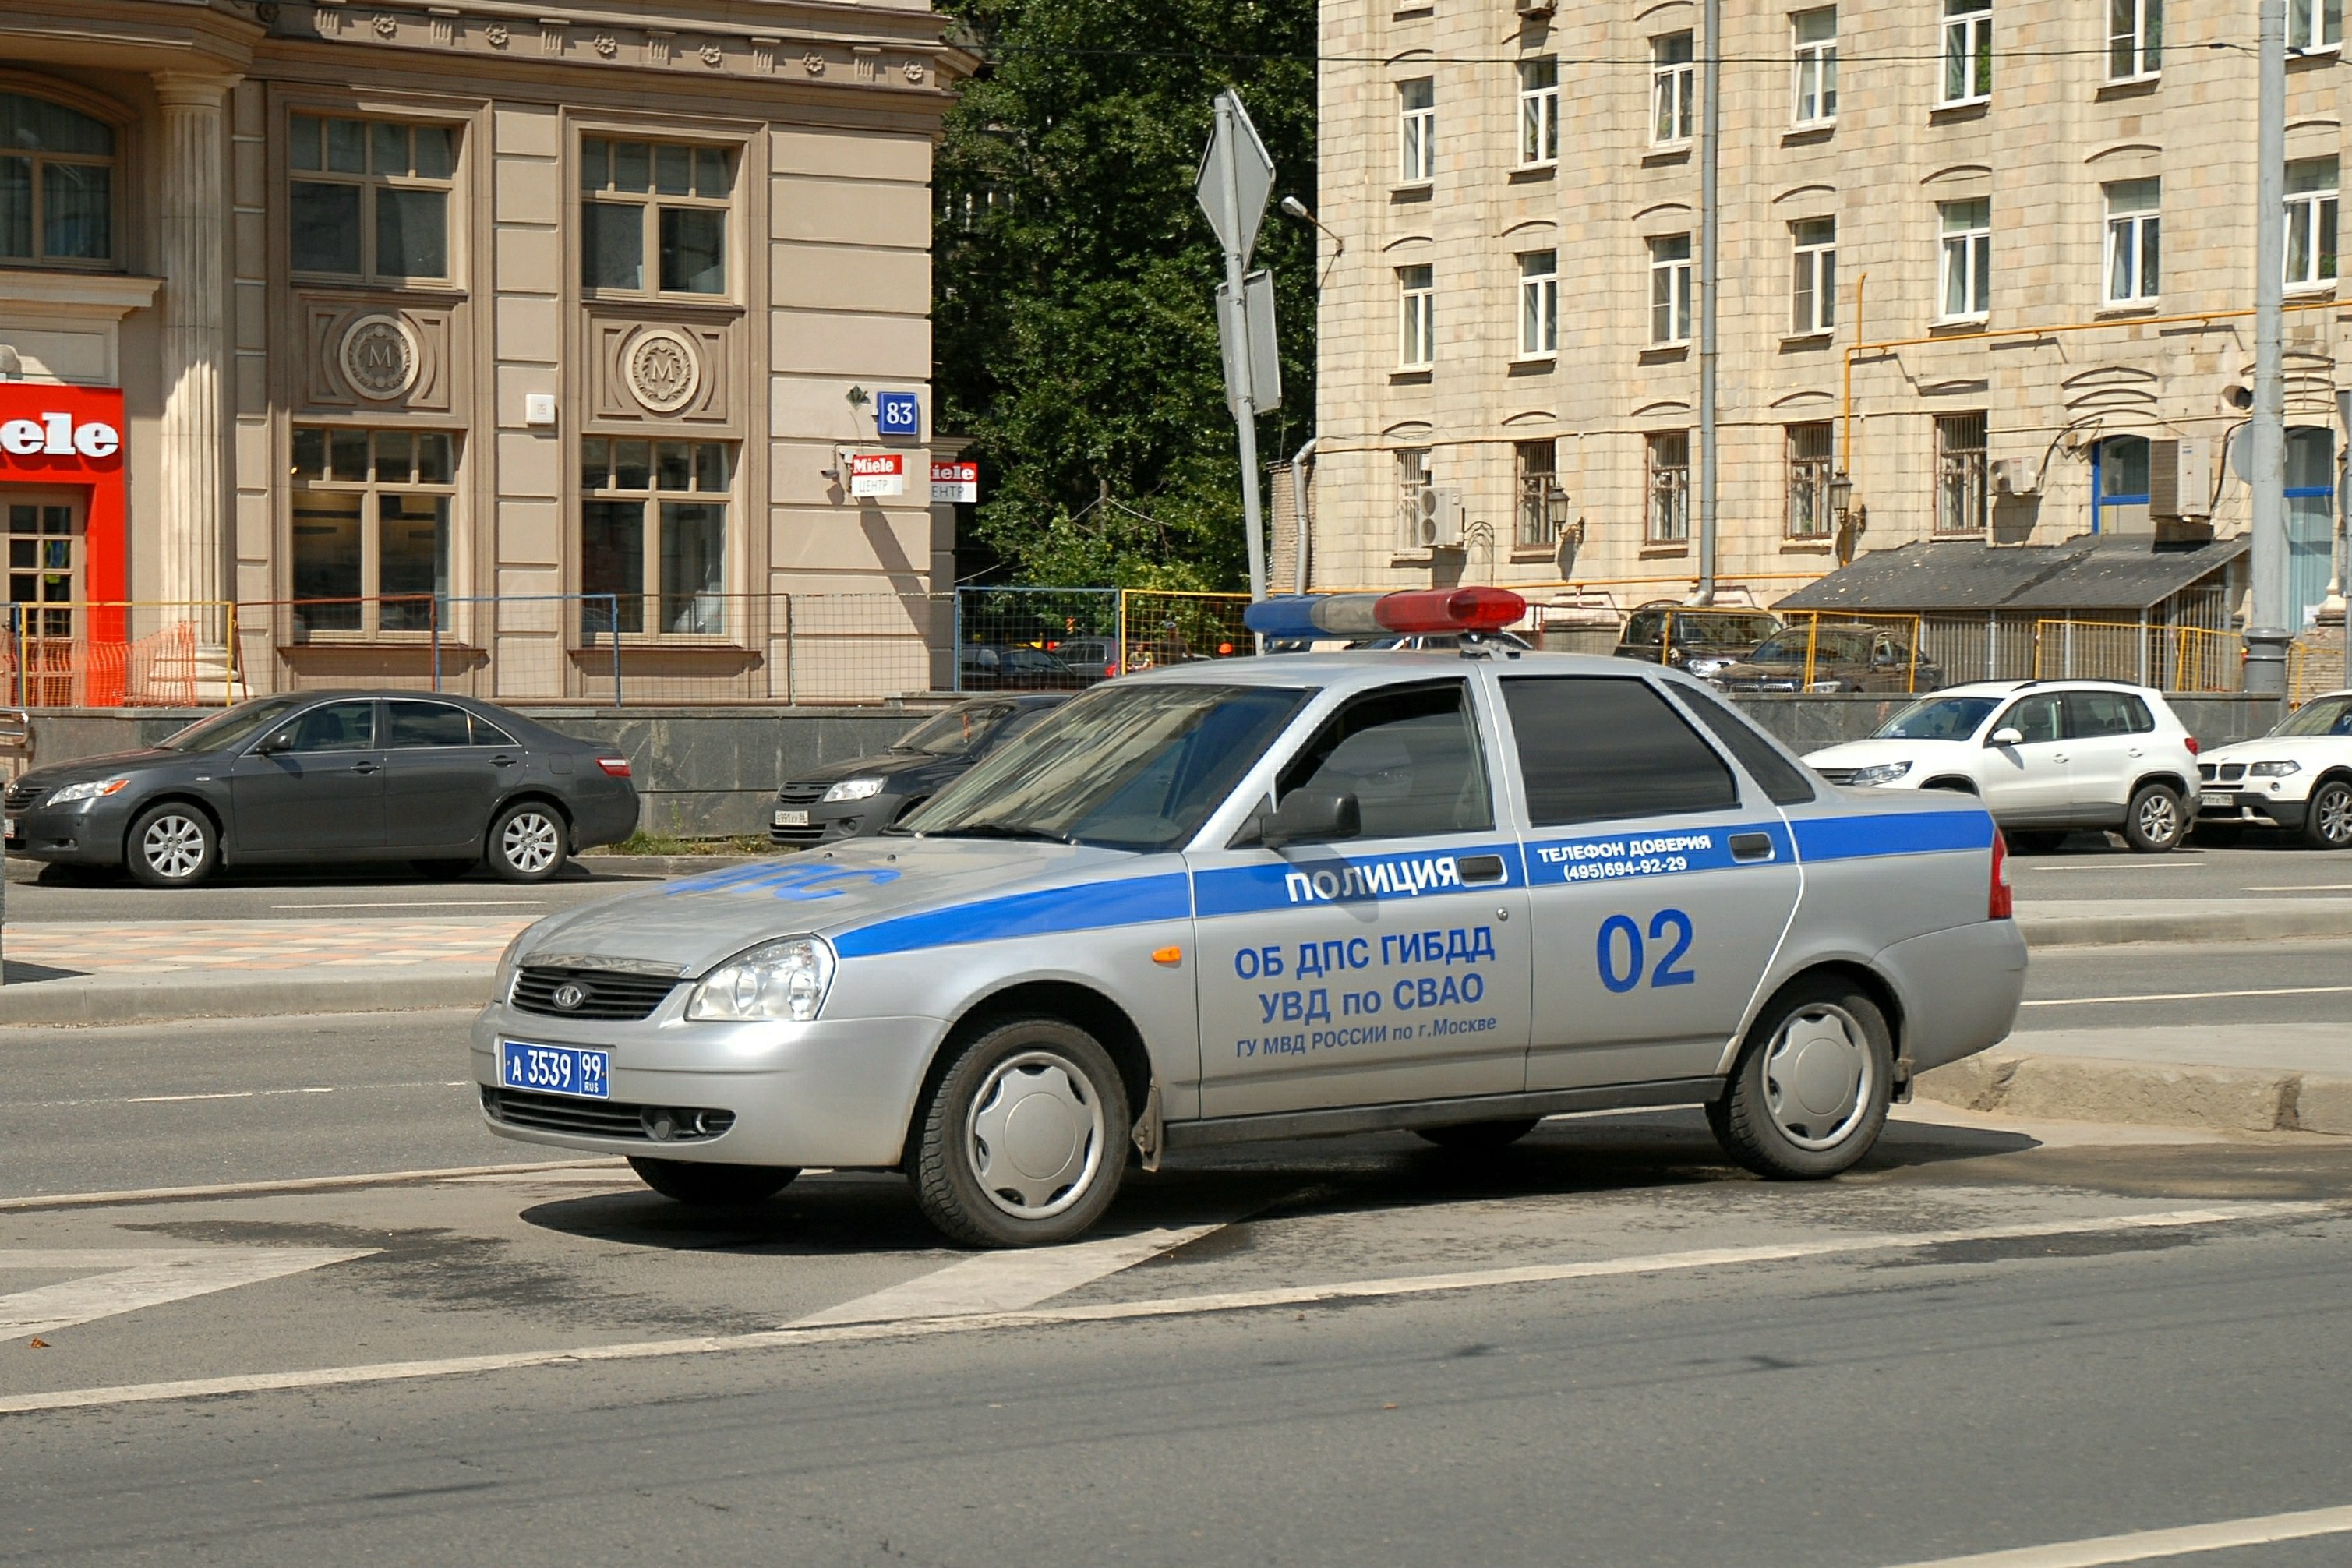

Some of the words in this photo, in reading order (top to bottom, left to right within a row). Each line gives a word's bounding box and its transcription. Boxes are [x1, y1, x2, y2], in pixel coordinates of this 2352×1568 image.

[369, 345, 391, 367] M
[652, 358, 675, 380] M
[886, 402, 913, 425] 83
[0, 411, 119, 457] ele
[853, 457, 895, 474] Miele
[931, 464, 975, 481] iele
[859, 479, 888, 493] ЦЕНТР
[931, 486, 965, 498] ЕНТР
[1537, 842, 1626, 863] ТЕЛЕФОН
[1629, 835, 1712, 857] ДОВЕРИЯ
[1285, 856, 1460, 903] ПОЛИЦИЯ
[1563, 856, 1688, 882] (495)694-92-29
[1234, 946, 1284, 980] ОБ
[1295, 938, 1370, 980] ДПС
[1380, 925, 1496, 966] ГИБДД
[1596, 908, 1695, 994] 02
[1259, 987, 1331, 1026] УВД
[1343, 991, 1382, 1015] по
[1393, 973, 1485, 1011] СВАО
[1236, 1039, 1257, 1058] ГУ
[1263, 1034, 1306, 1054] МВД
[1312, 1025, 1387, 1050] РОССИИ
[1393, 1027, 1413, 1040] по
[1418, 1017, 1497, 1038] г.Москве
[528, 1049, 571, 1088] 3539
[582, 1054, 601, 1082] 99
[584, 1081, 599, 1093] RUS
